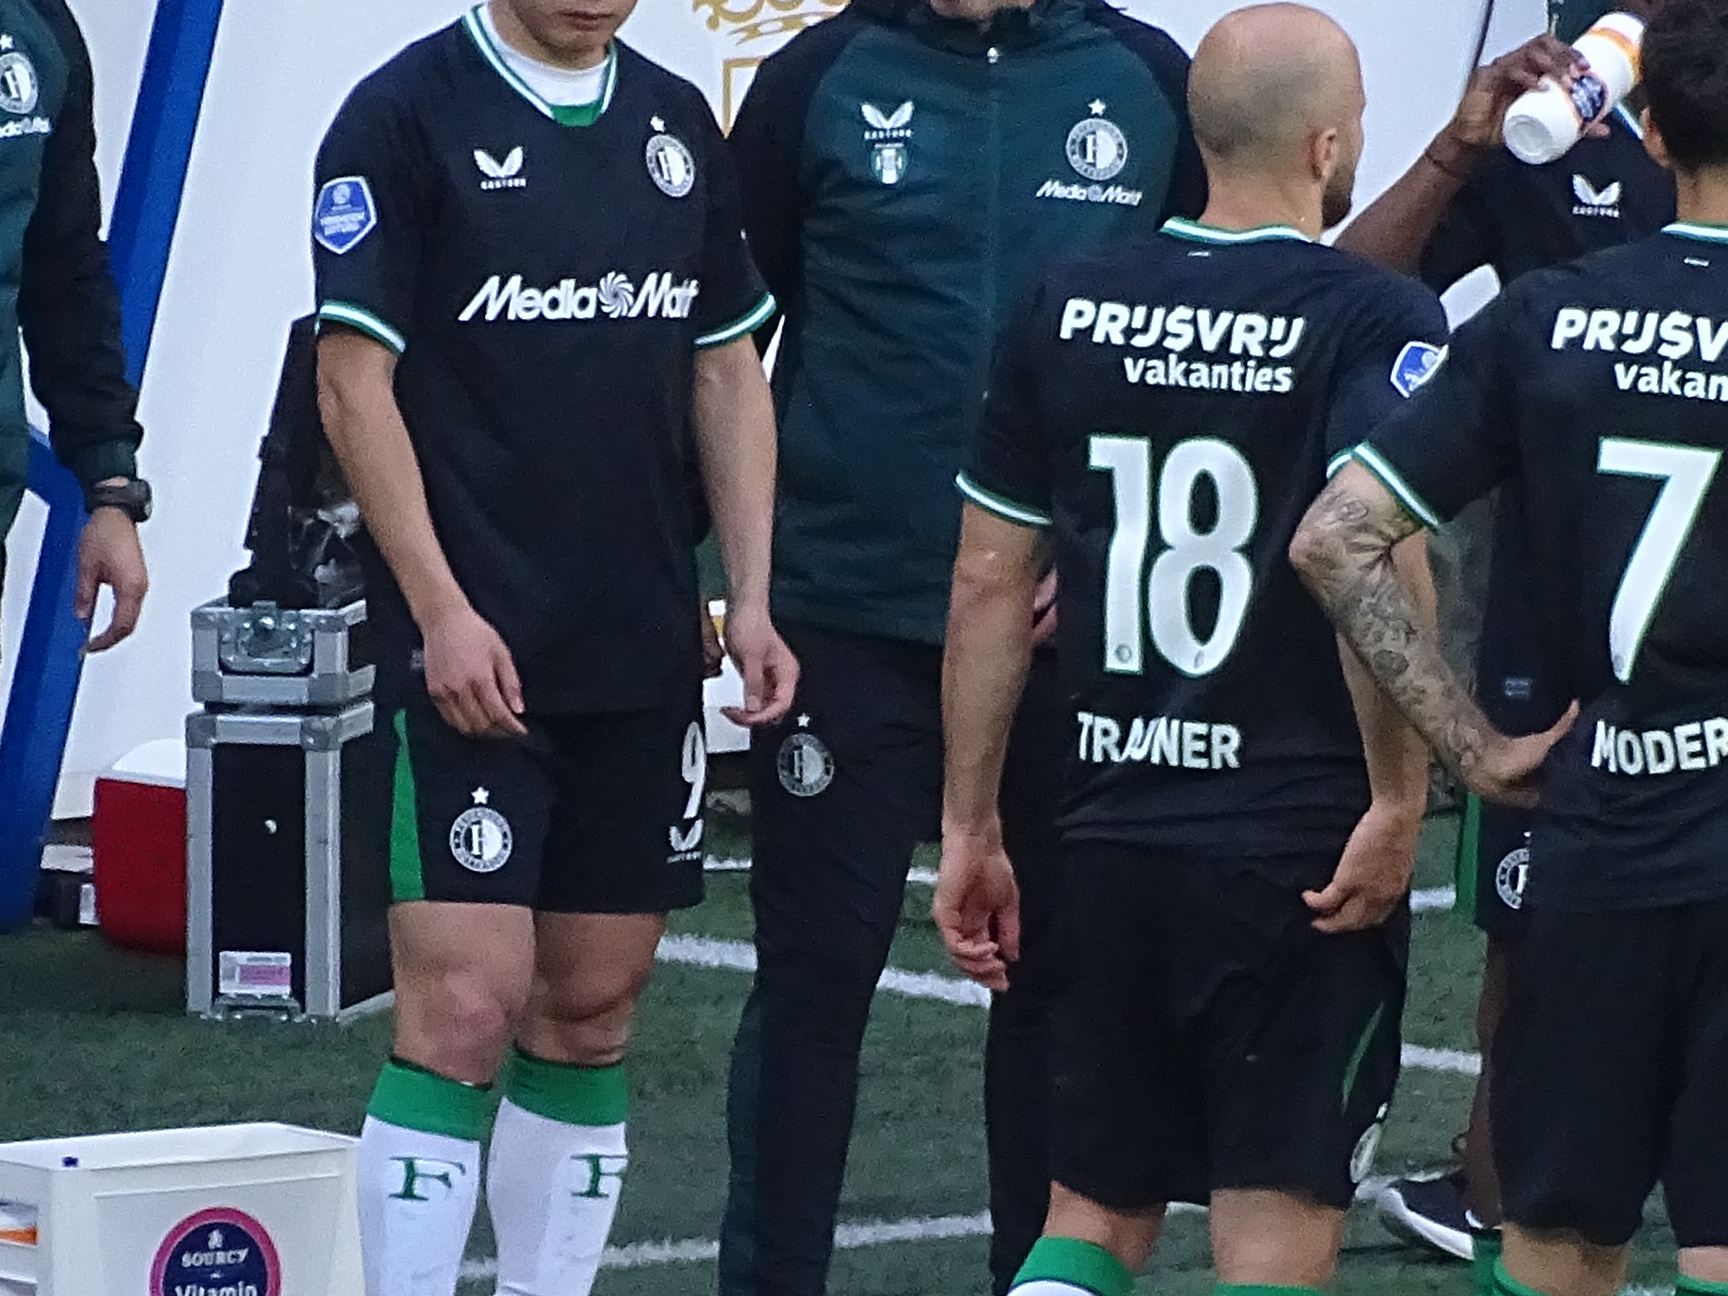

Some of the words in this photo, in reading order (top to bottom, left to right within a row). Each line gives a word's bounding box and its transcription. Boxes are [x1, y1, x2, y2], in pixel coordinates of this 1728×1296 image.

[457, 273, 598, 322] Media
[1124, 353, 1294, 394] vakanties
[1087, 434, 1260, 678] 18
[1595, 436, 1723, 686] 7
[681, 721, 707, 820] 9
[388, 1156, 467, 1201] F
